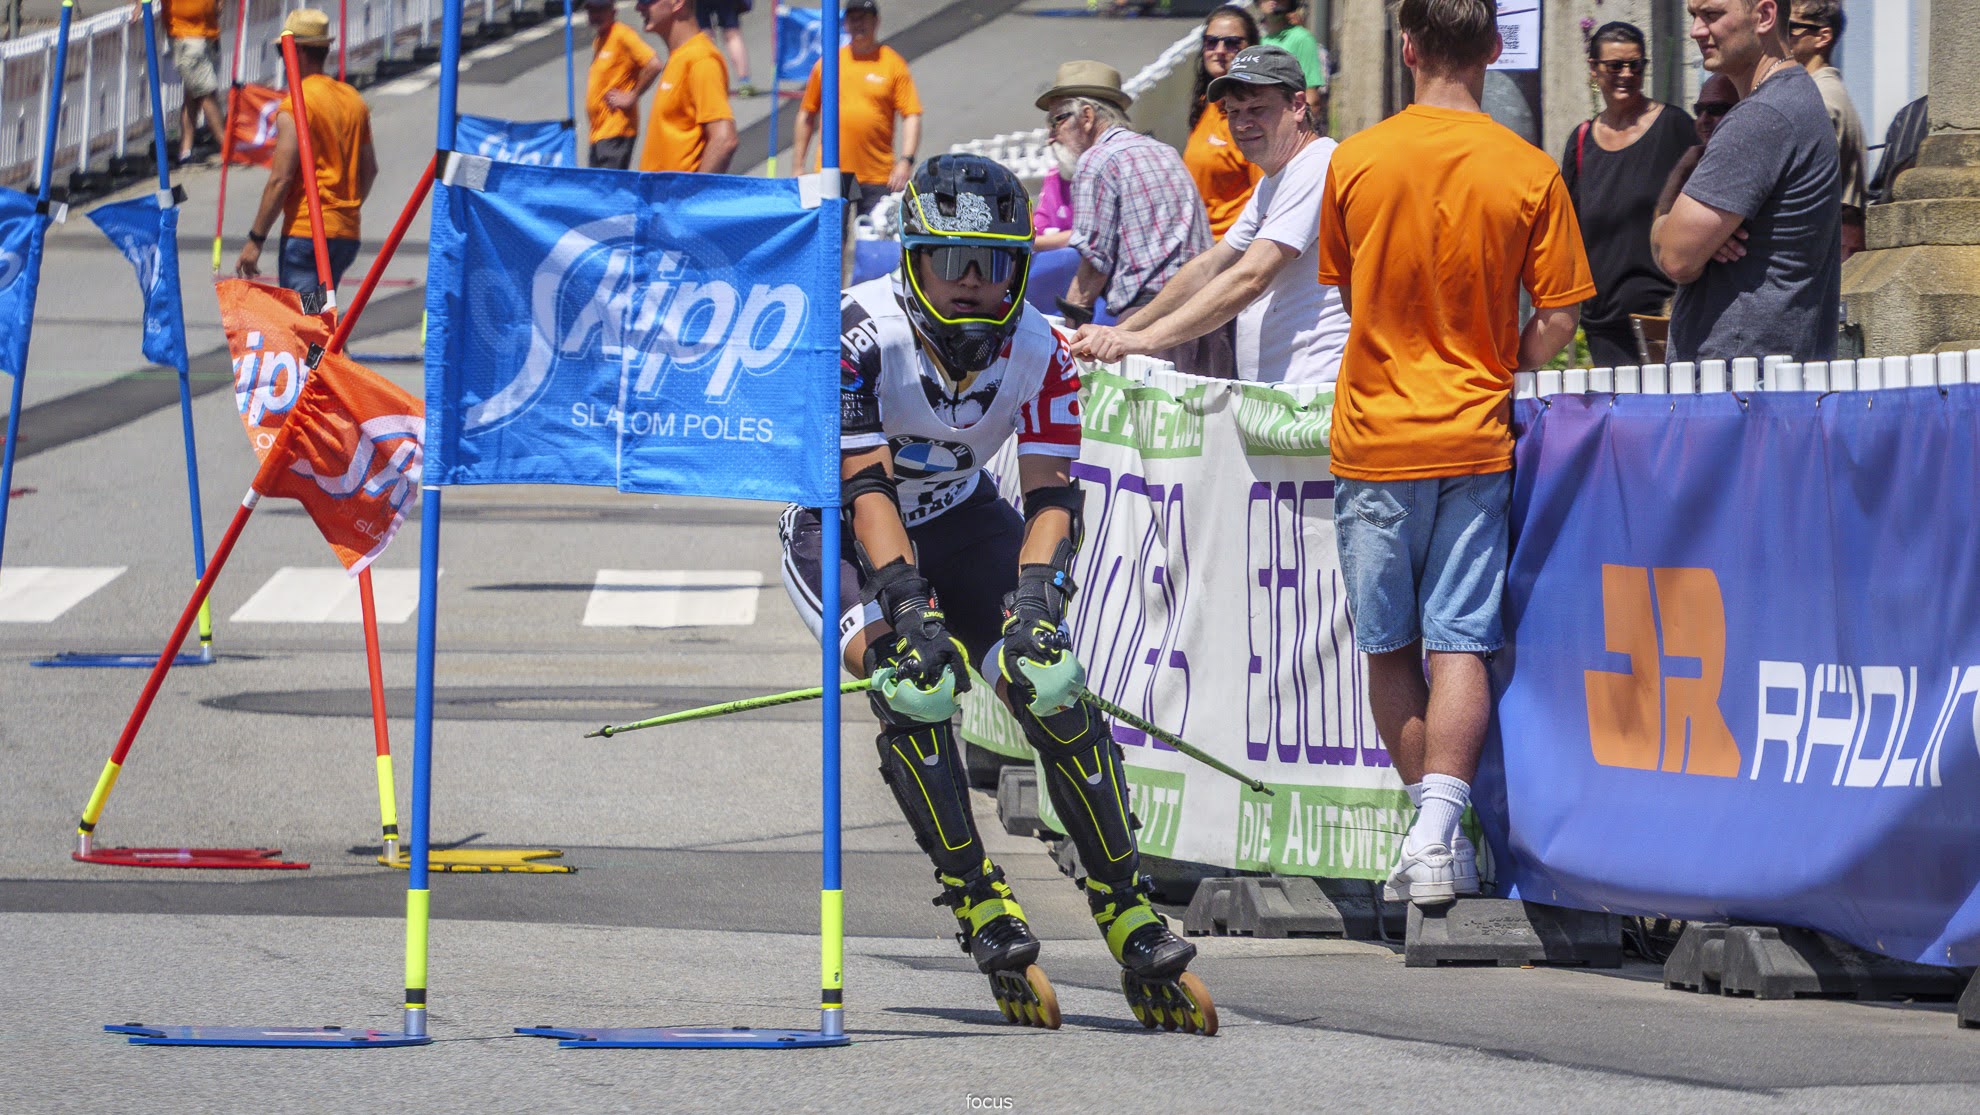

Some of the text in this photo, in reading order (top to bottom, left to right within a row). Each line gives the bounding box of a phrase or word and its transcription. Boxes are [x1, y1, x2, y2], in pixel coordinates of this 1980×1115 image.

[463, 213, 809, 438] Skipp
[571, 402, 773, 443] SLALOM POLES
[896, 436, 968, 457] BMW
[1239, 398, 1332, 450] WWW.REIFE
[1749, 659, 1980, 788] RÄDLIN
[1239, 800, 1273, 863] DIE
[1282, 791, 1416, 871] AUTOWER
